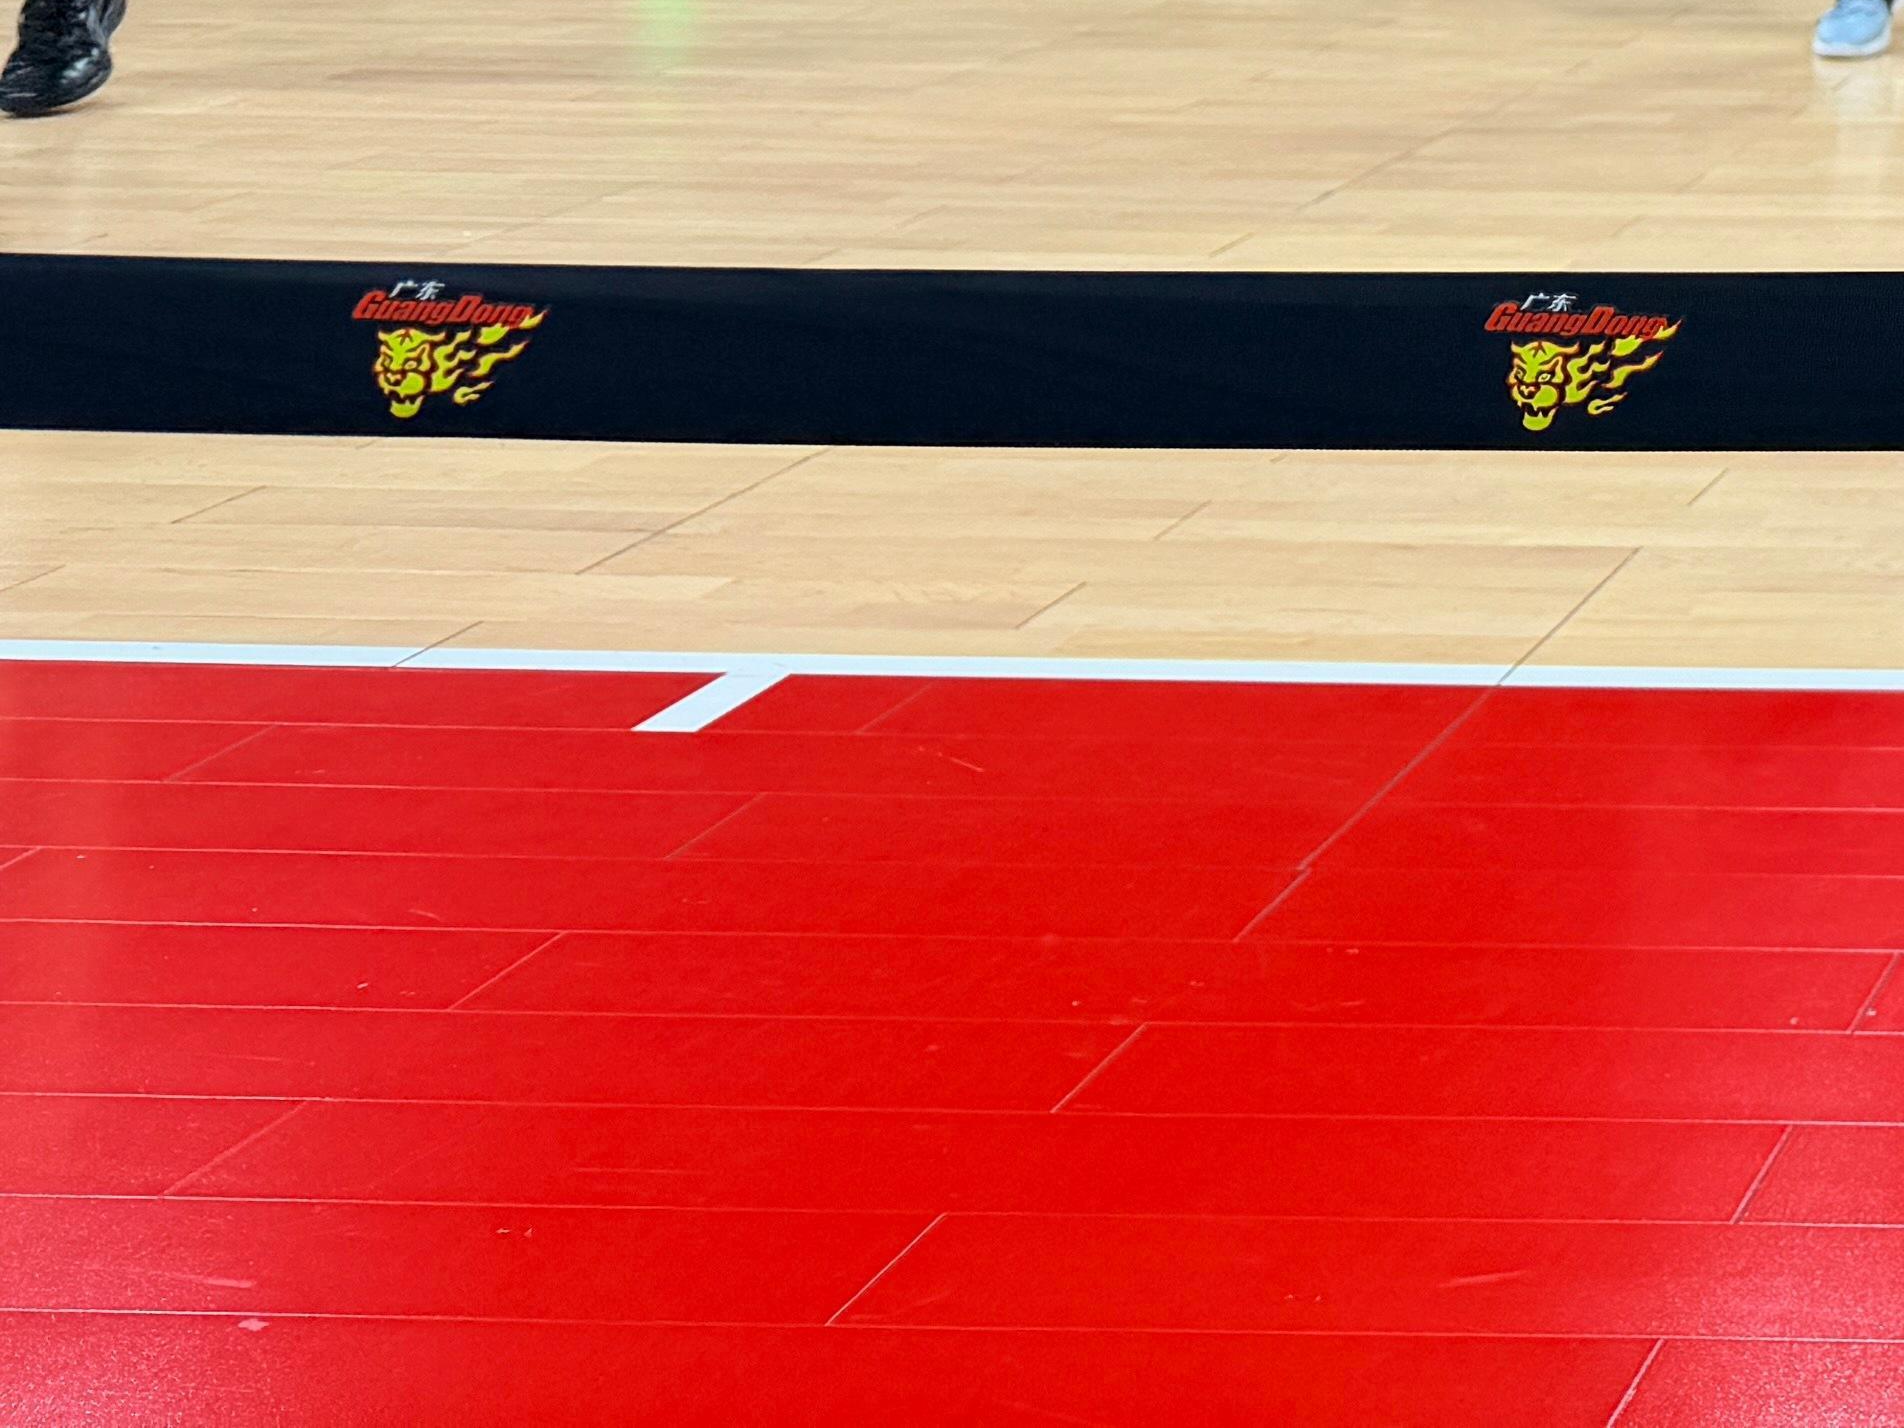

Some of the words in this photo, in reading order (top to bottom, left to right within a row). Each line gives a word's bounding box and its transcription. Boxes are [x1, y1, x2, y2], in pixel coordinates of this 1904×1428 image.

[388, 279, 446, 300] 广东
[1519, 292, 1578, 312] 广东
[352, 289, 538, 330] GuangDong
[1484, 301, 1670, 341] GuangDong
